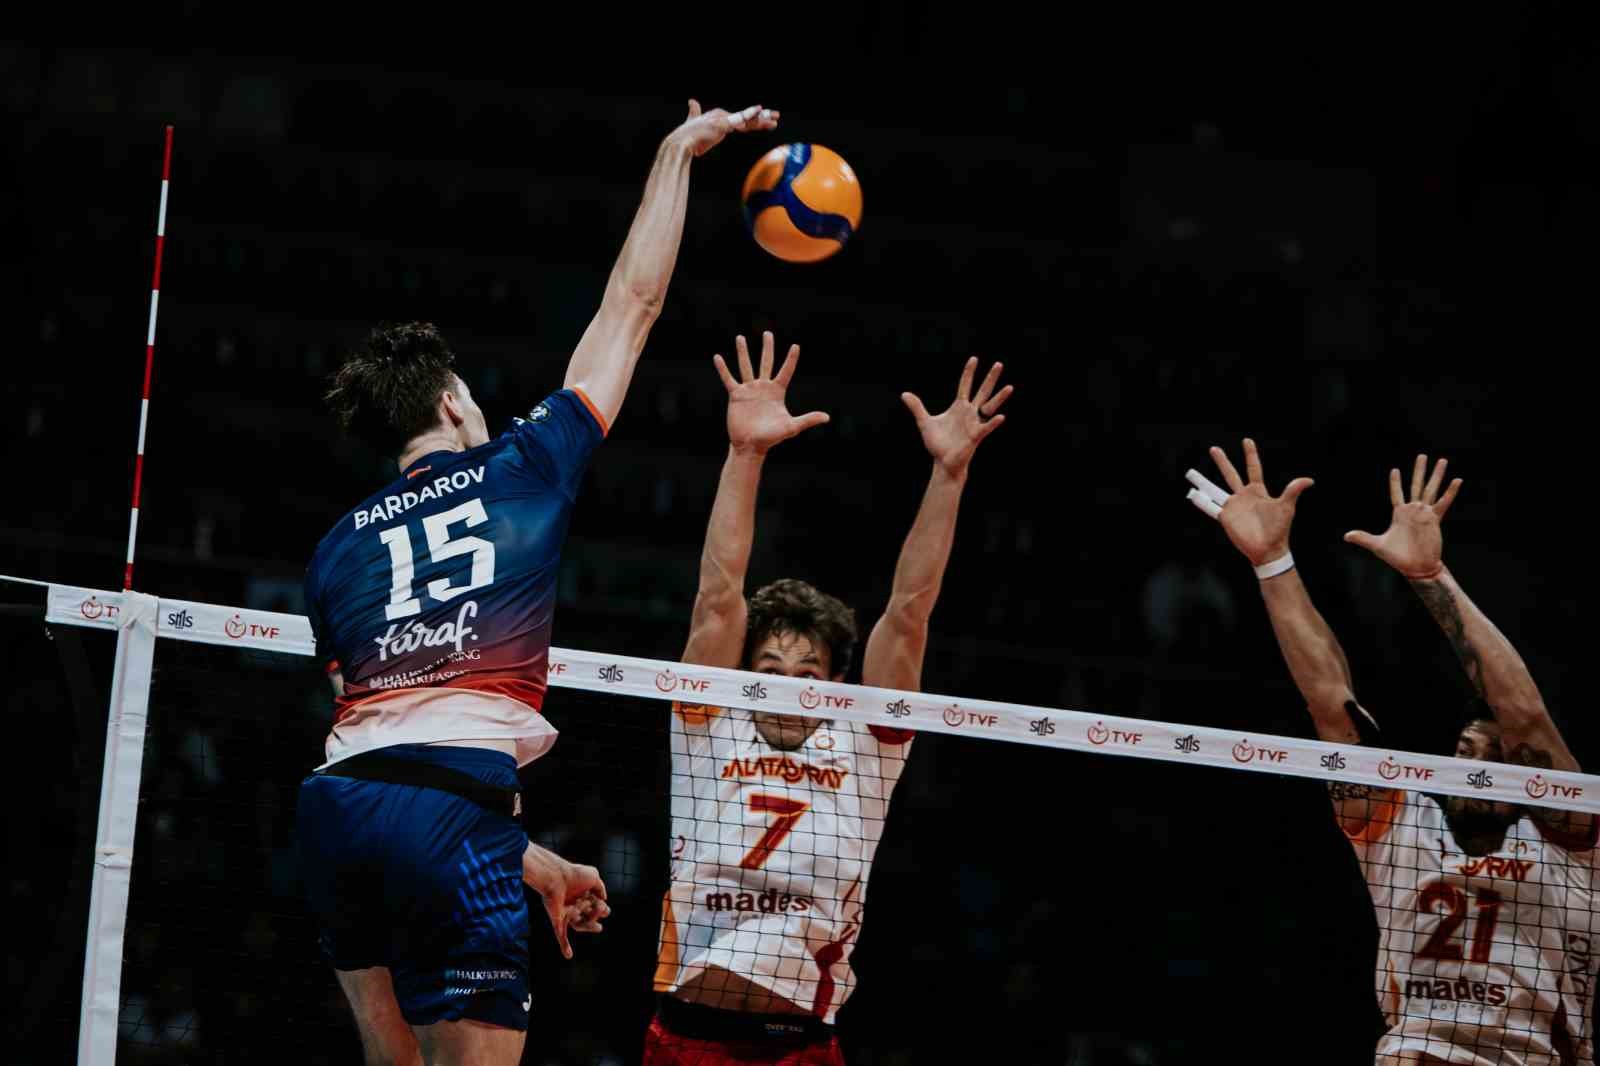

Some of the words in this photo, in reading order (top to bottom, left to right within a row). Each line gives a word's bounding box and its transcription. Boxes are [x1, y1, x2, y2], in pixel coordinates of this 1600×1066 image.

[354, 466, 486, 530] BARDAROV
[379, 498, 496, 622] 15
[250, 624, 281, 639] TVF
[548, 663, 567, 676] VF
[680, 676, 711, 692] TVF
[823, 695, 855, 711] TVF
[967, 712, 998, 728] TVF
[1111, 730, 1143, 746] TVF
[1257, 748, 1288, 764] TVF
[1403, 766, 1435, 782] TVF
[1550, 784, 1583, 800] TVF
[739, 793, 813, 870] 7
[706, 888, 811, 913] mades
[1415, 879, 1505, 964] 21
[1405, 976, 1507, 1005] mades
